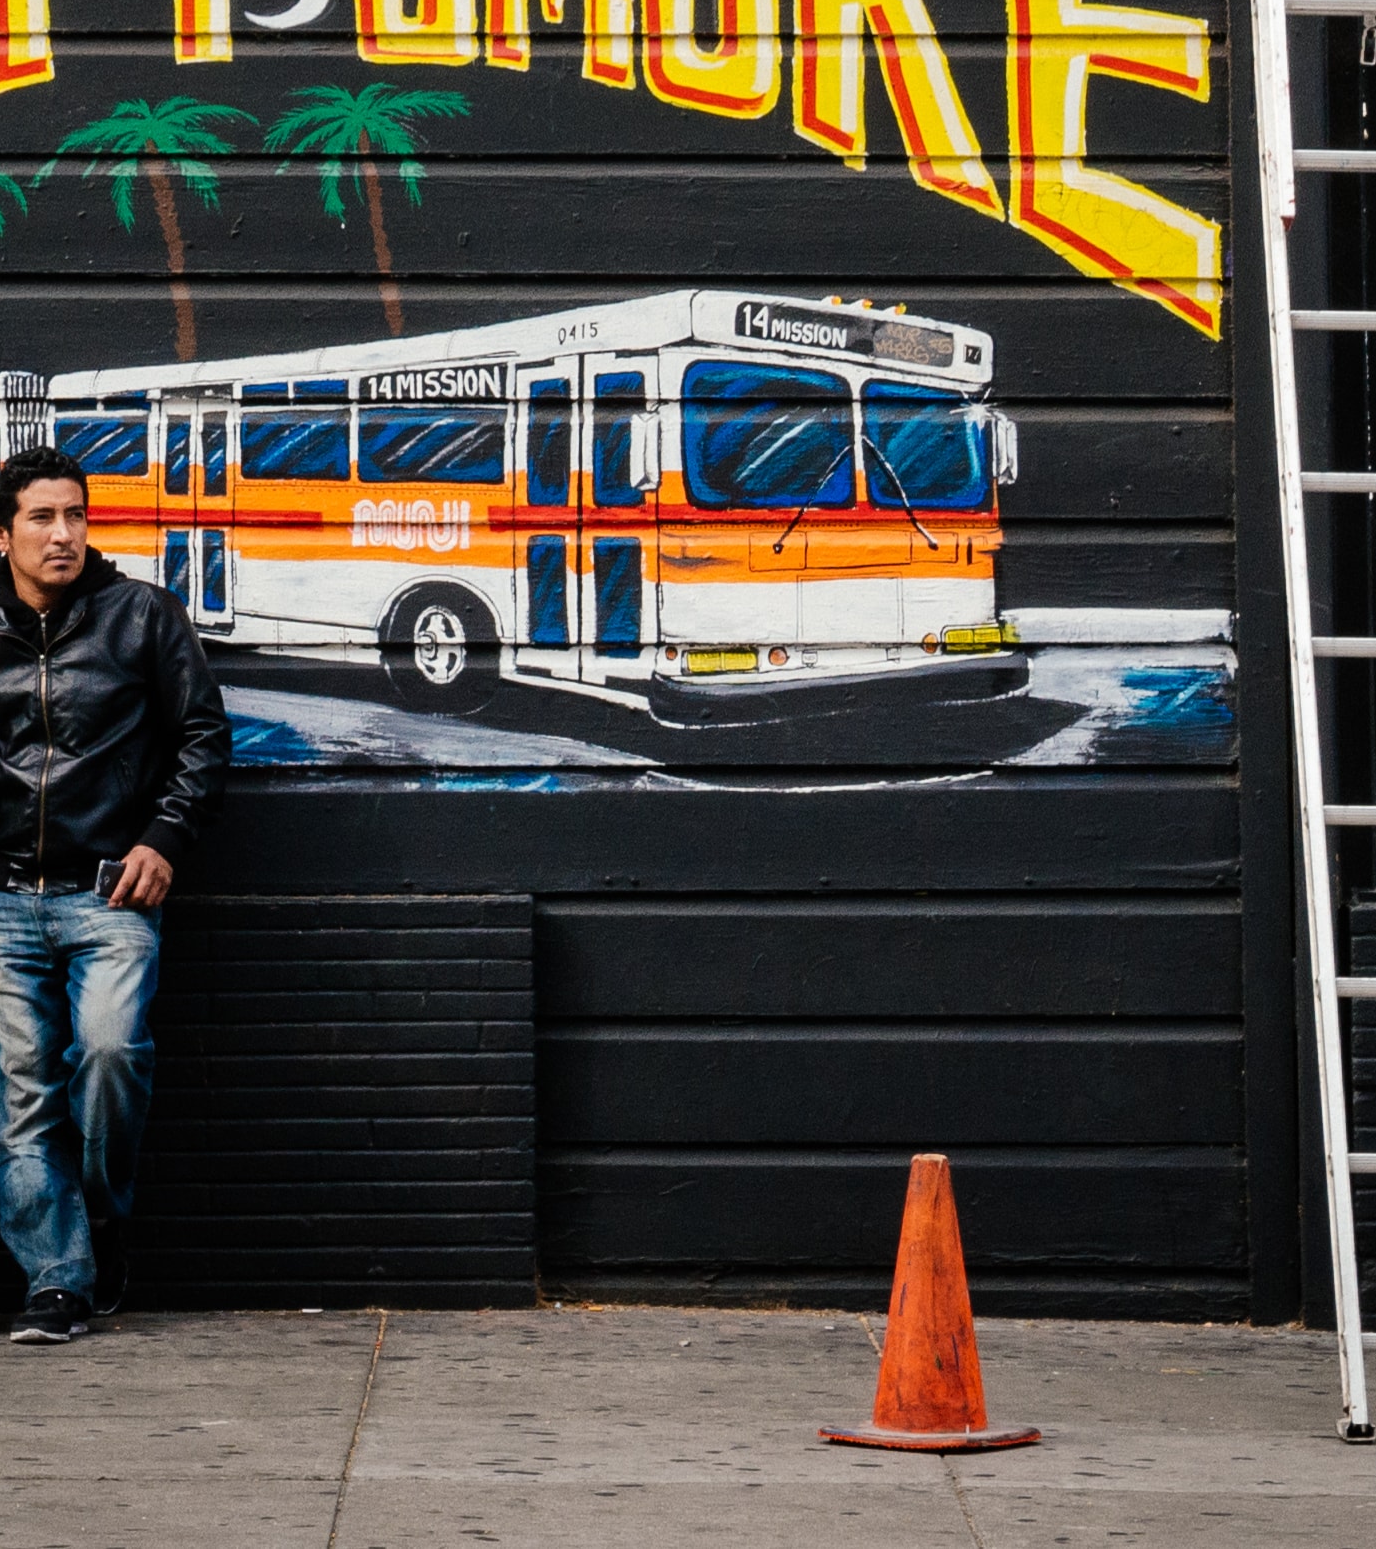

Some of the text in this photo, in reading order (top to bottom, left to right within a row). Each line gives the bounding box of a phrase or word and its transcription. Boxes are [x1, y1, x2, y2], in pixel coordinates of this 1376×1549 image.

[743, 304, 770, 339] 14
[771, 318, 848, 349] MISSION
[368, 365, 501, 400] 14 MISSION
